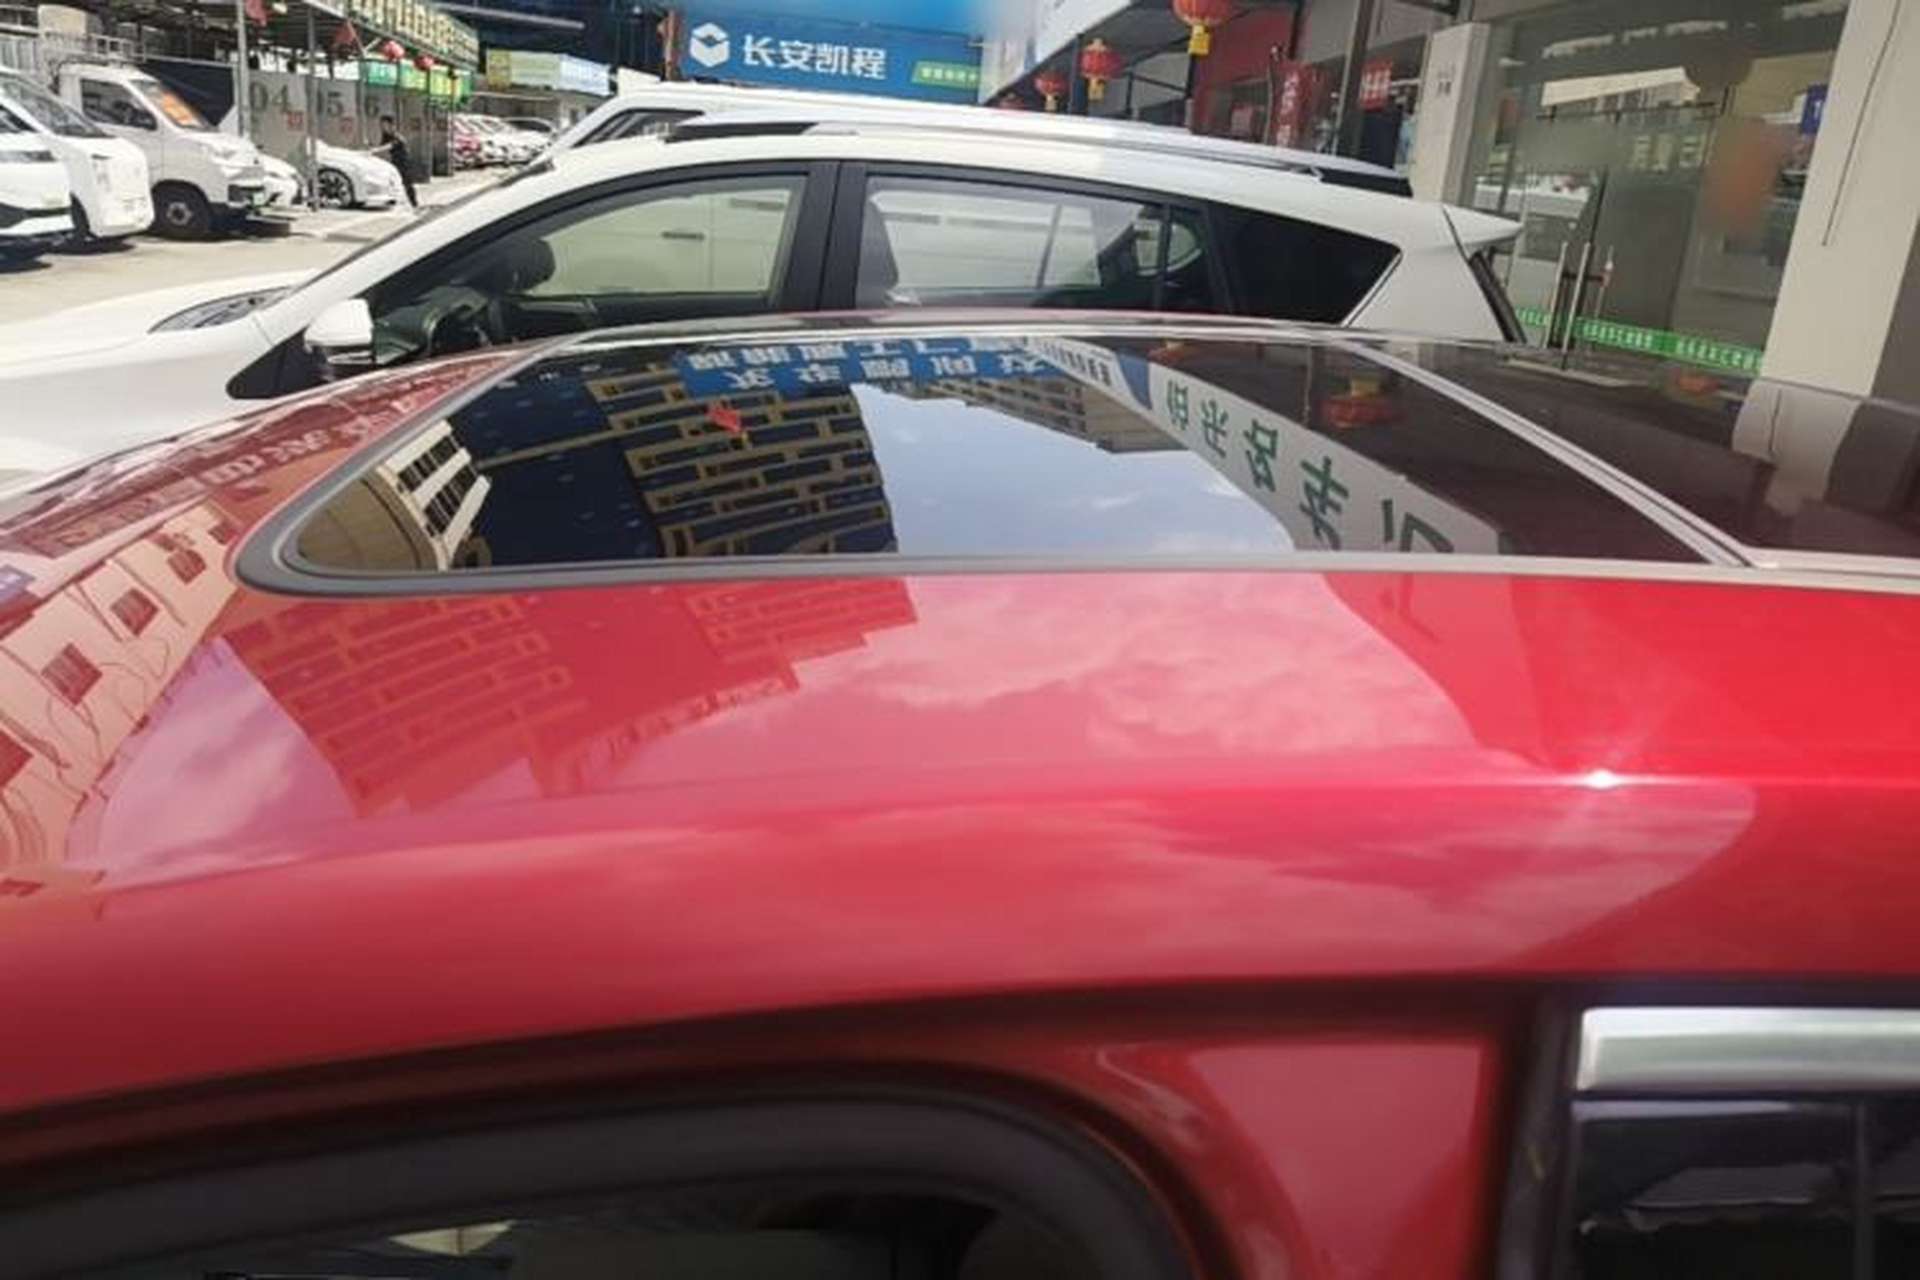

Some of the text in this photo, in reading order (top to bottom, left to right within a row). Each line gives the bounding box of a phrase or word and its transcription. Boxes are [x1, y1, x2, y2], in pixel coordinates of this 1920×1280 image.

[743, 35, 887, 81] 长安凯程
[249, 82, 289, 113] 04
